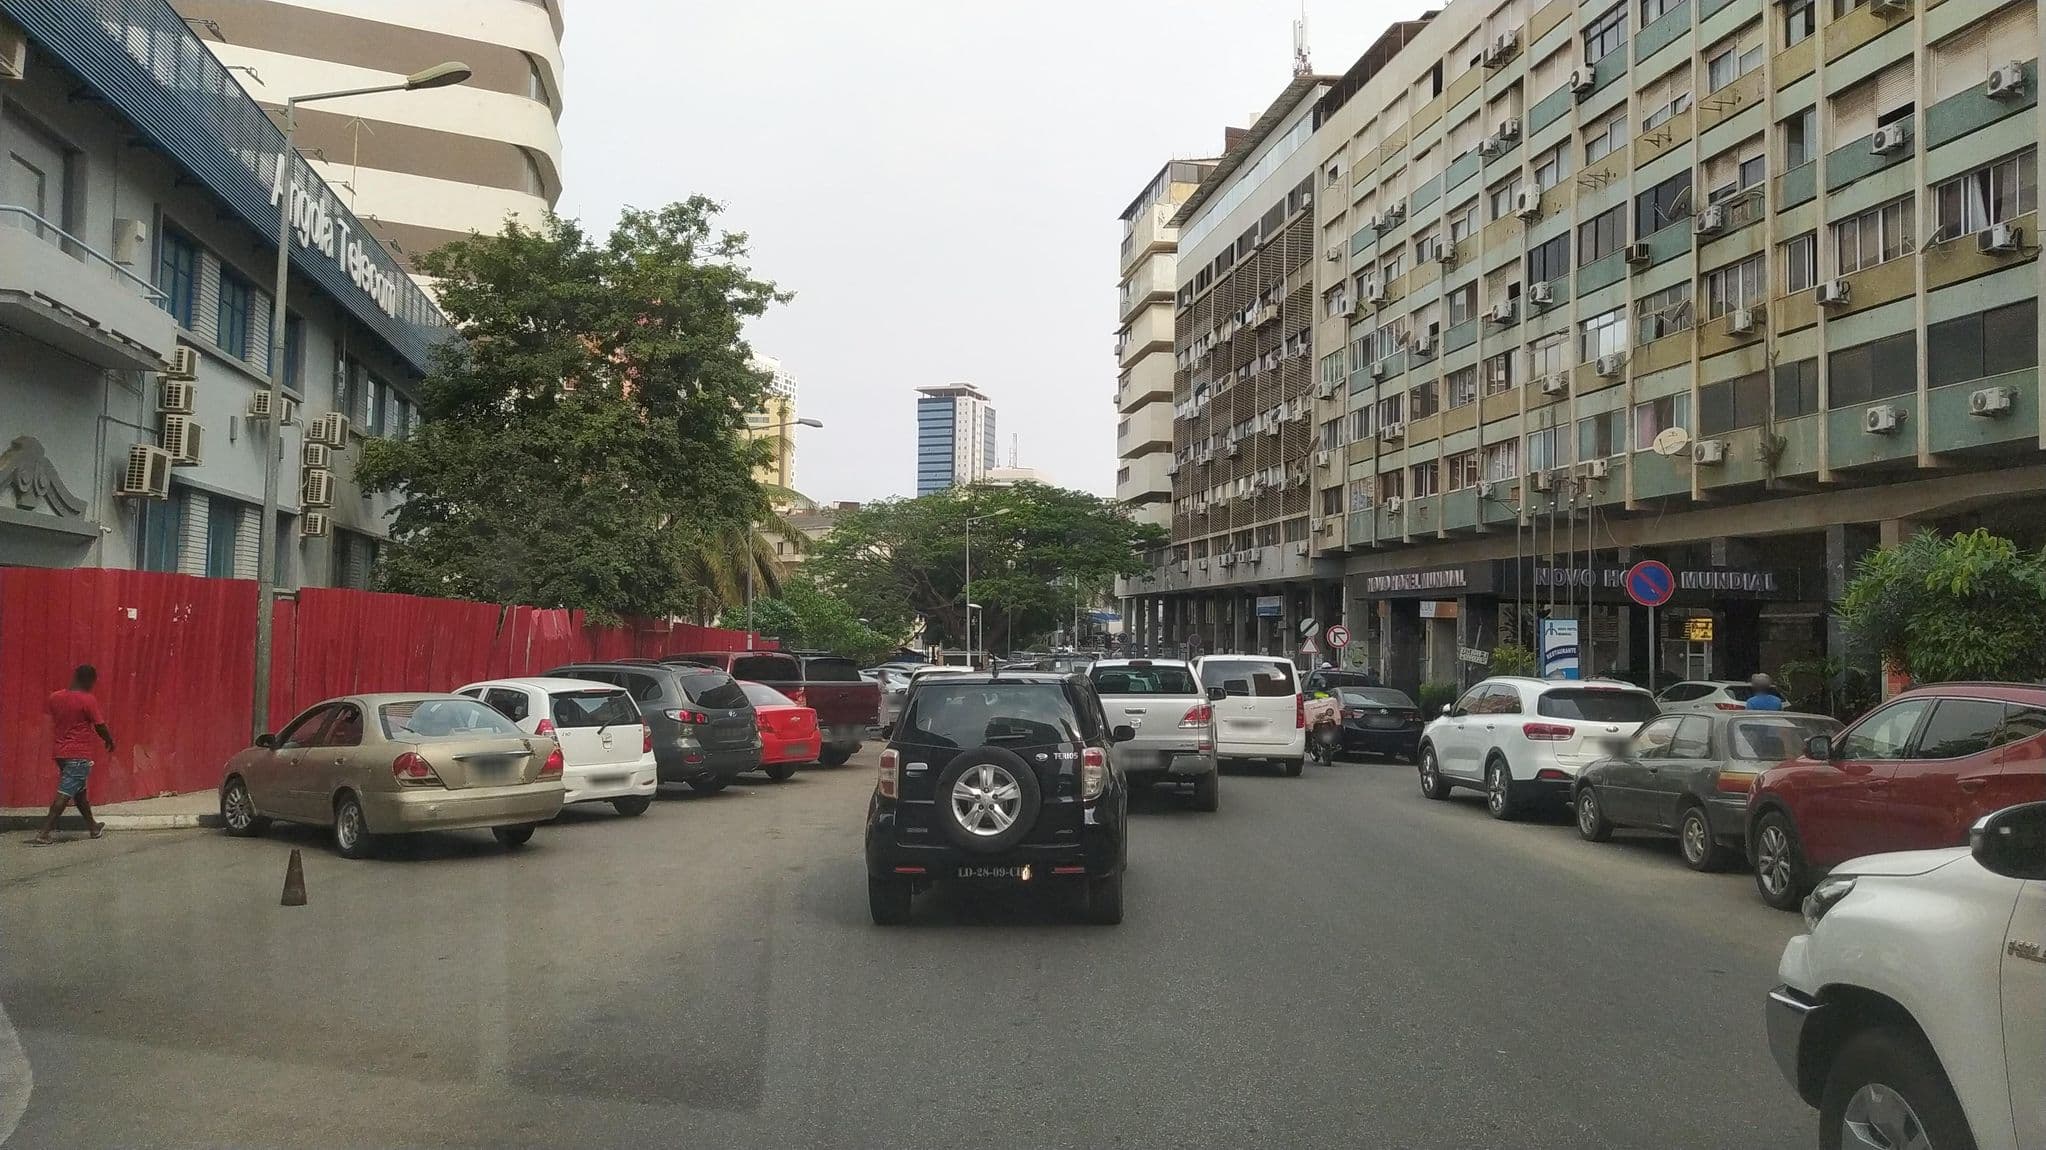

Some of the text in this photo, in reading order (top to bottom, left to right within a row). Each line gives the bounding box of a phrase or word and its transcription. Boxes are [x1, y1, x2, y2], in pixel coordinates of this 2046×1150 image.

[271, 153, 396, 319] Angola Telecom
[1367, 575, 1391, 593] NOVO
[1421, 569, 1467, 589] MUNDIAL
[1535, 567, 1597, 587] NOVO
[1681, 571, 1778, 592] MUNDIAL
[1053, 751, 1079, 760] TERIOS
